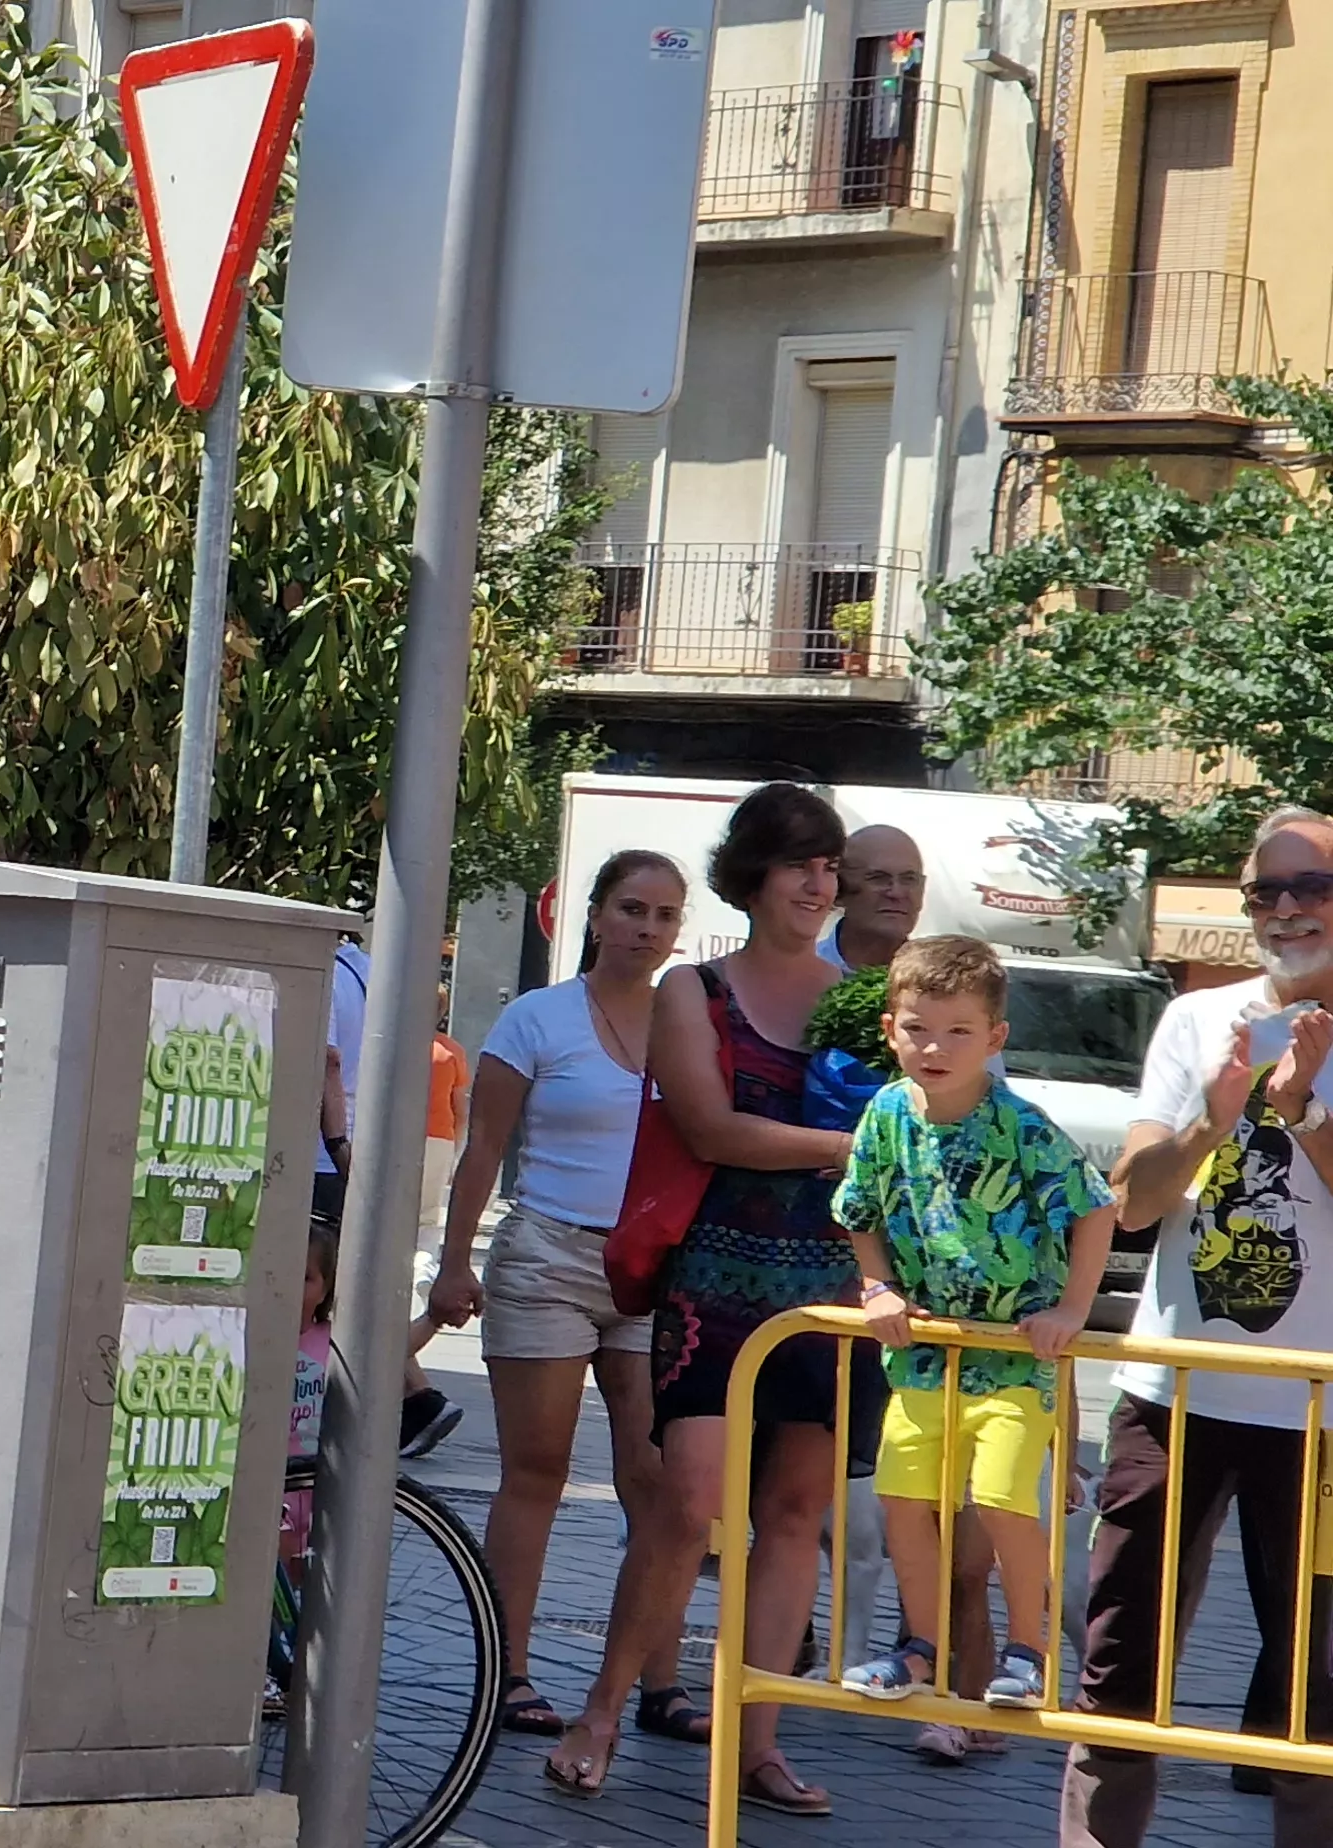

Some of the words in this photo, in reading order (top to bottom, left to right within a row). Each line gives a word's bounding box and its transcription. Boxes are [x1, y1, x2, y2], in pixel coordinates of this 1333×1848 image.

[149, 1030, 271, 1101] GREEN
[157, 1092, 252, 1149] FRIDAY
[119, 1354, 242, 1418] GREEN
[128, 1416, 220, 1467] FRIDAY
